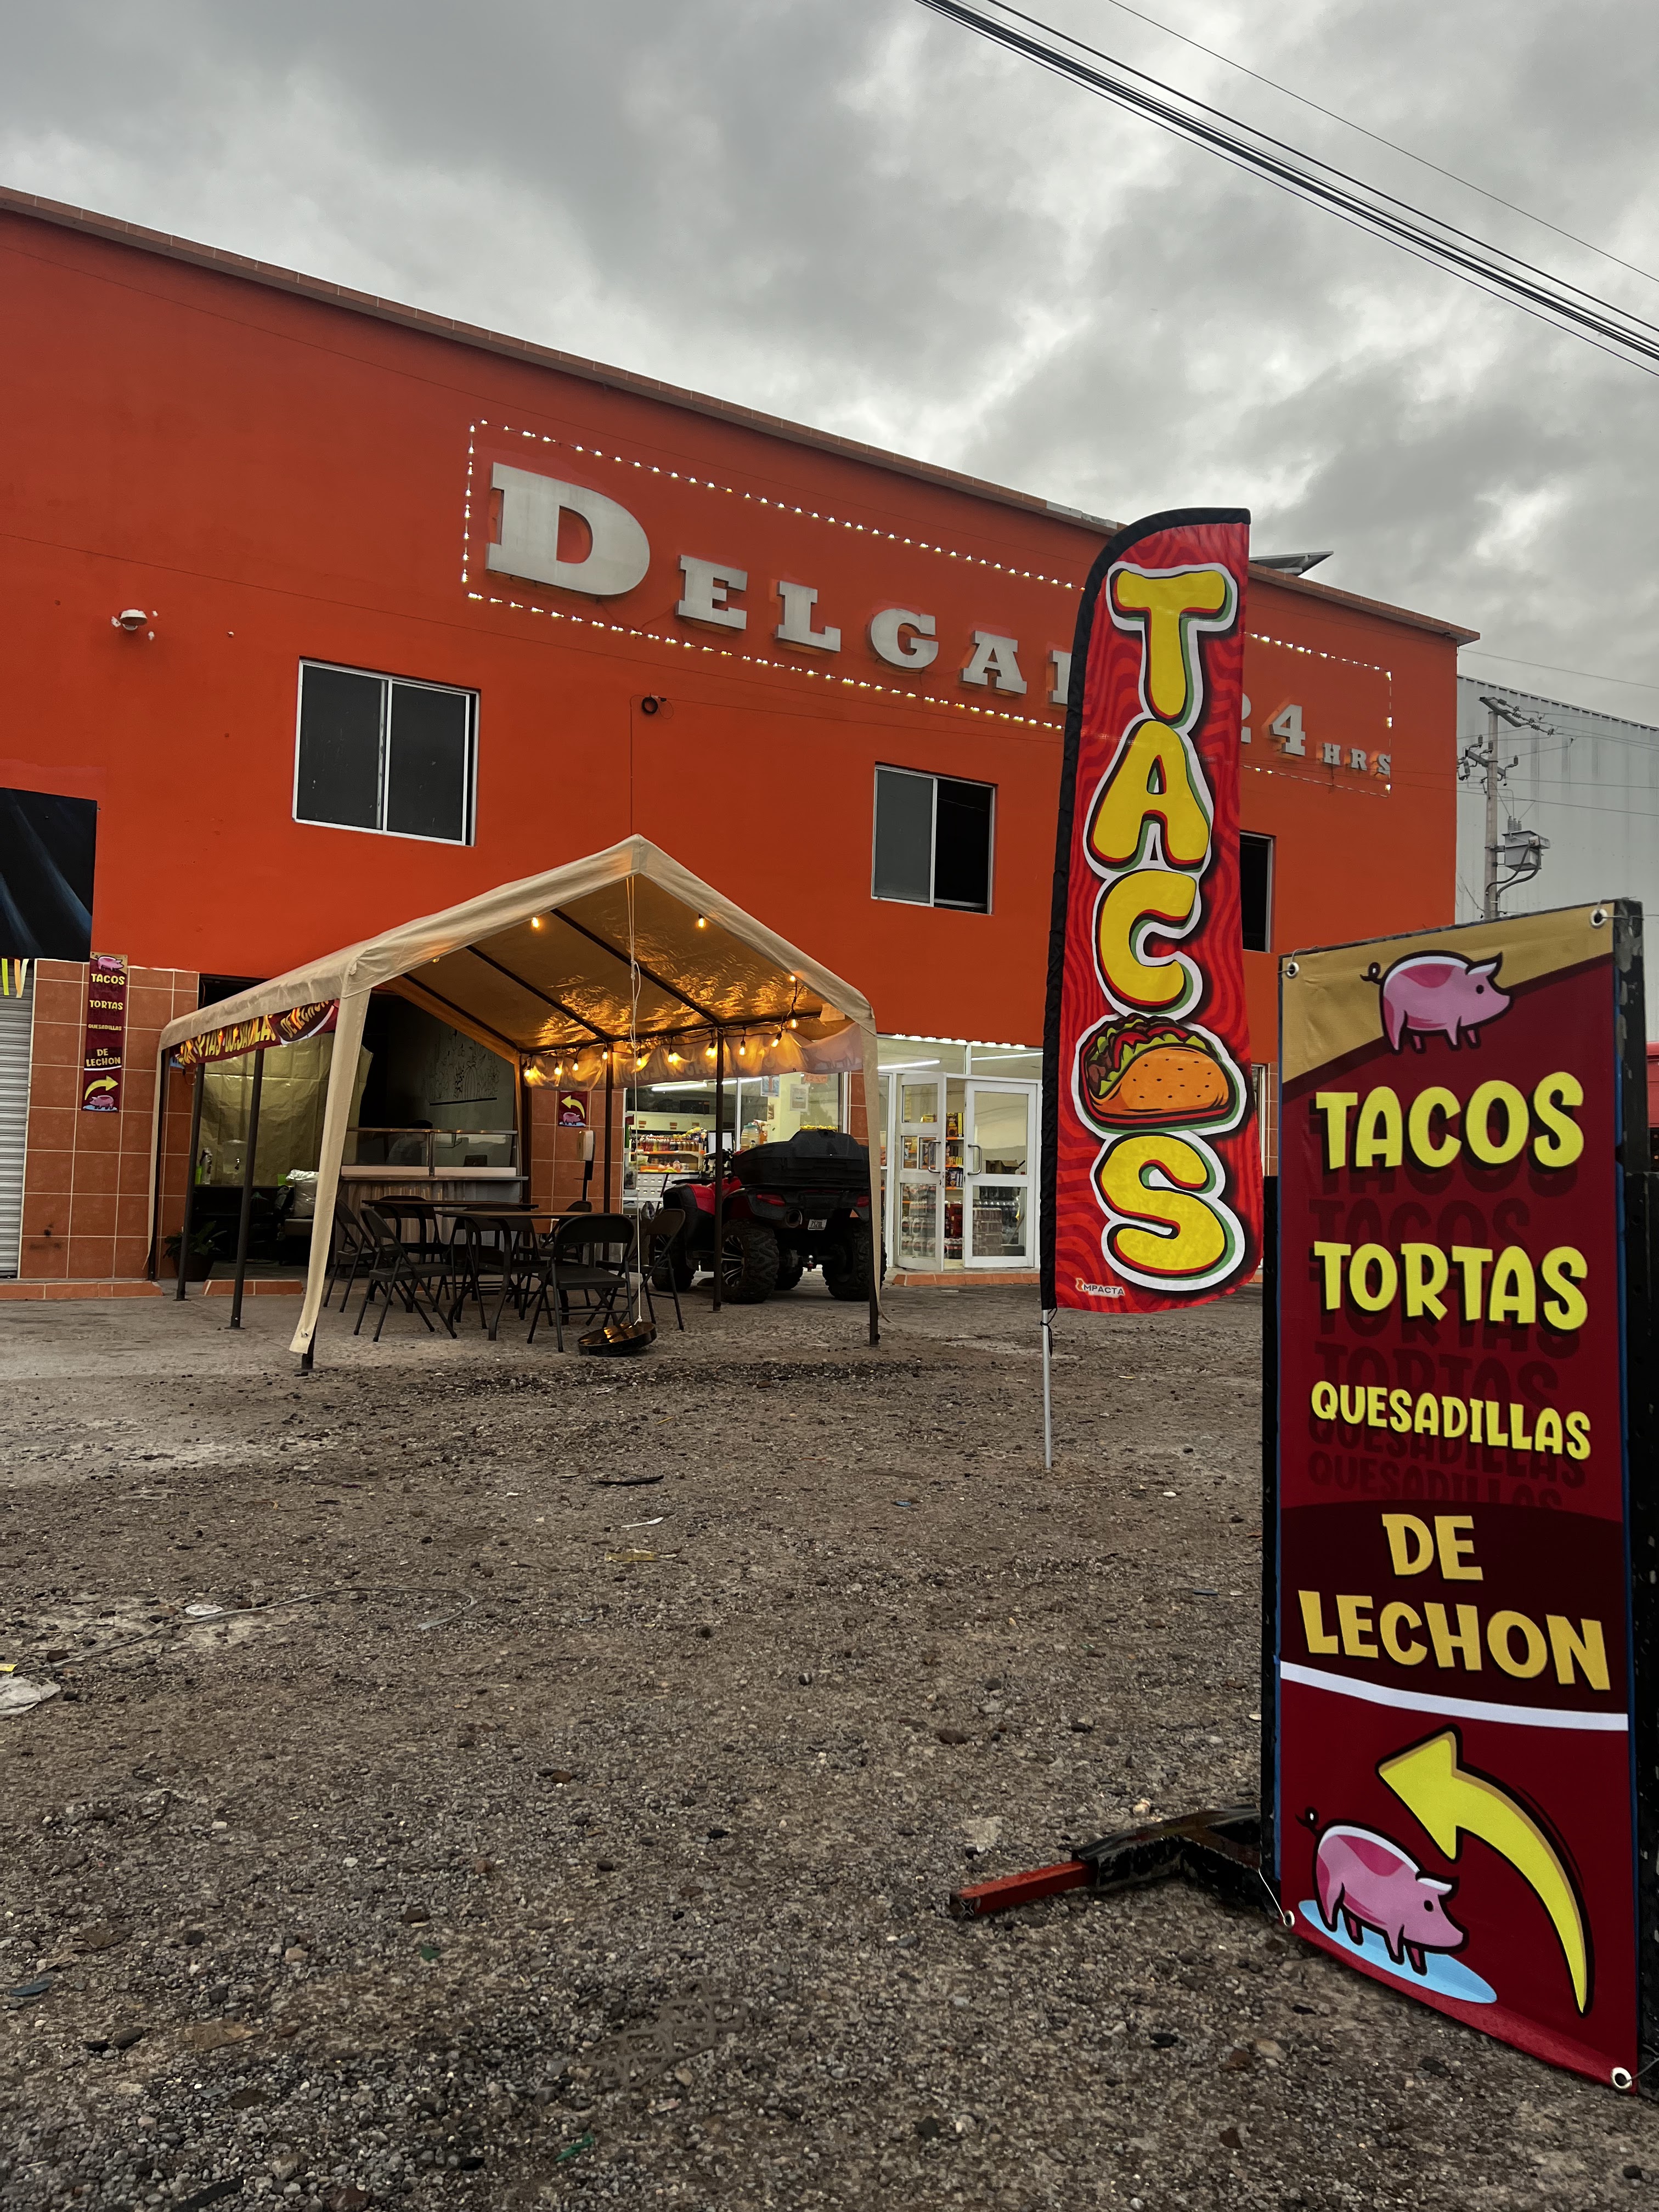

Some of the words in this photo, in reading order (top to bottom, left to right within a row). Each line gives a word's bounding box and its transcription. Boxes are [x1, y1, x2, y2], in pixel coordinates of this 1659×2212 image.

[1322, 742, 1391, 776] HRS
[91, 973, 125, 985] TACOS
[89, 1000, 123, 1011] TORTAS
[86, 1057, 121, 1067] LECHON
[97, 1048, 109, 1057] DE
[1316, 1072, 1584, 1169] TACOS
[1314, 1241, 1588, 1330] TORTAS
[1311, 1381, 1590, 1460] QUESADILLAS
[1381, 1514, 1483, 1581] DE
[1298, 1590, 1611, 1690] LECHON
